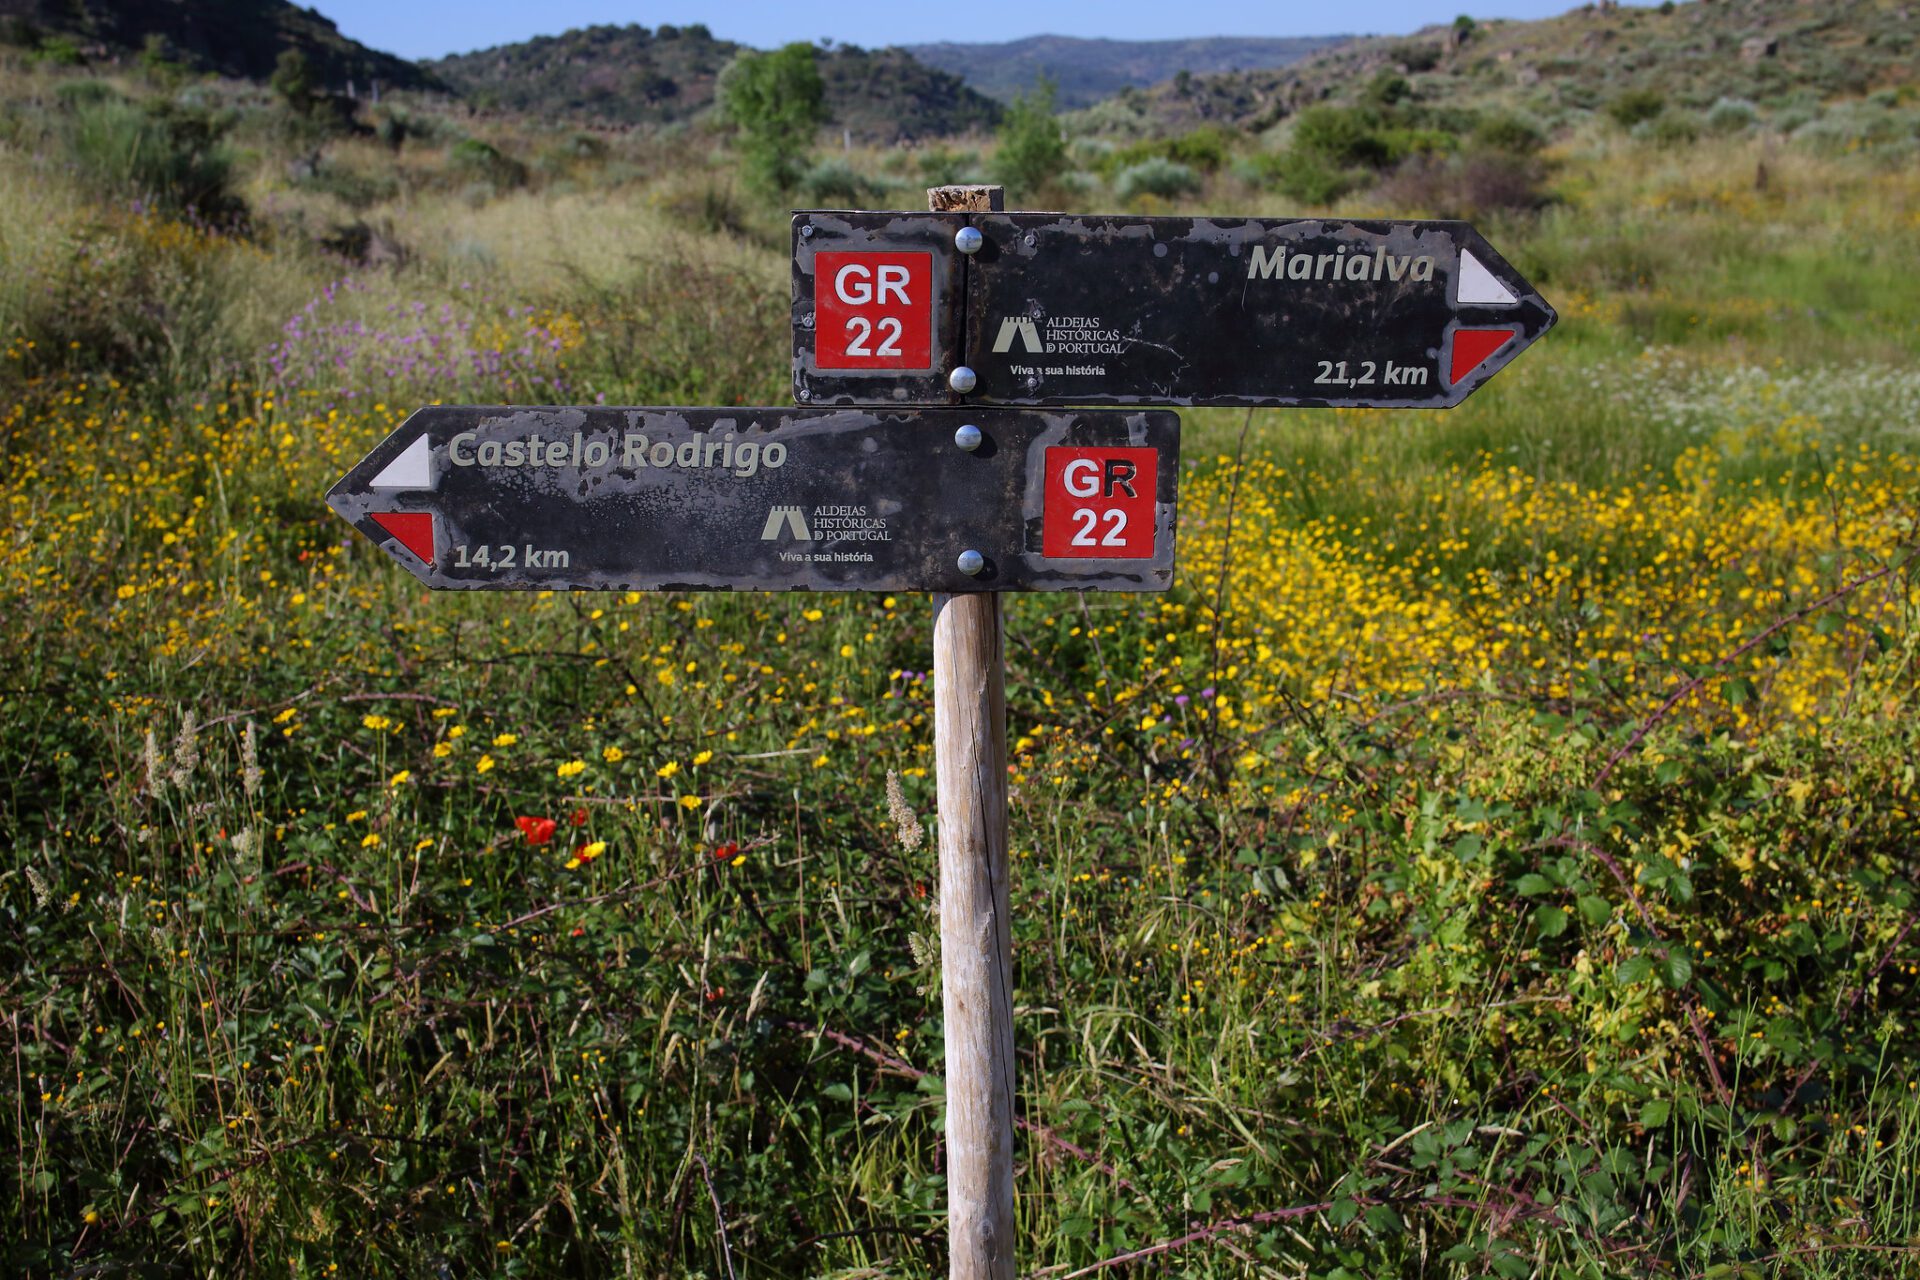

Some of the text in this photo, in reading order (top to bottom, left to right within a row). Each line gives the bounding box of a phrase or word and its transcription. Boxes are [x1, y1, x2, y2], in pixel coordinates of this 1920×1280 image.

[1247, 244, 1435, 282] Marialva
[834, 263, 912, 305] GR
[1046, 317, 1100, 328] ALDEIAS
[1046, 326, 1120, 341] HISTÓRICAS
[844, 316, 903, 357] 22
[1058, 343, 1125, 354] PORTUGAL
[1010, 365, 1034, 375] Viva
[1045, 367, 1064, 375] sua
[1066, 365, 1106, 376] história
[1313, 360, 1429, 389] 21,2 km
[449, 433, 788, 478] Castelo Rodrigo
[1063, 458, 1138, 498] GR
[814, 506, 867, 517] ALDEIAS
[814, 515, 887, 529] HISTÓRICAS
[826, 531, 892, 541] PORTUGAL
[1071, 508, 1128, 546] 22
[454, 544, 571, 573] 14,2 km
[779, 552, 874, 562] Viva a sua história
